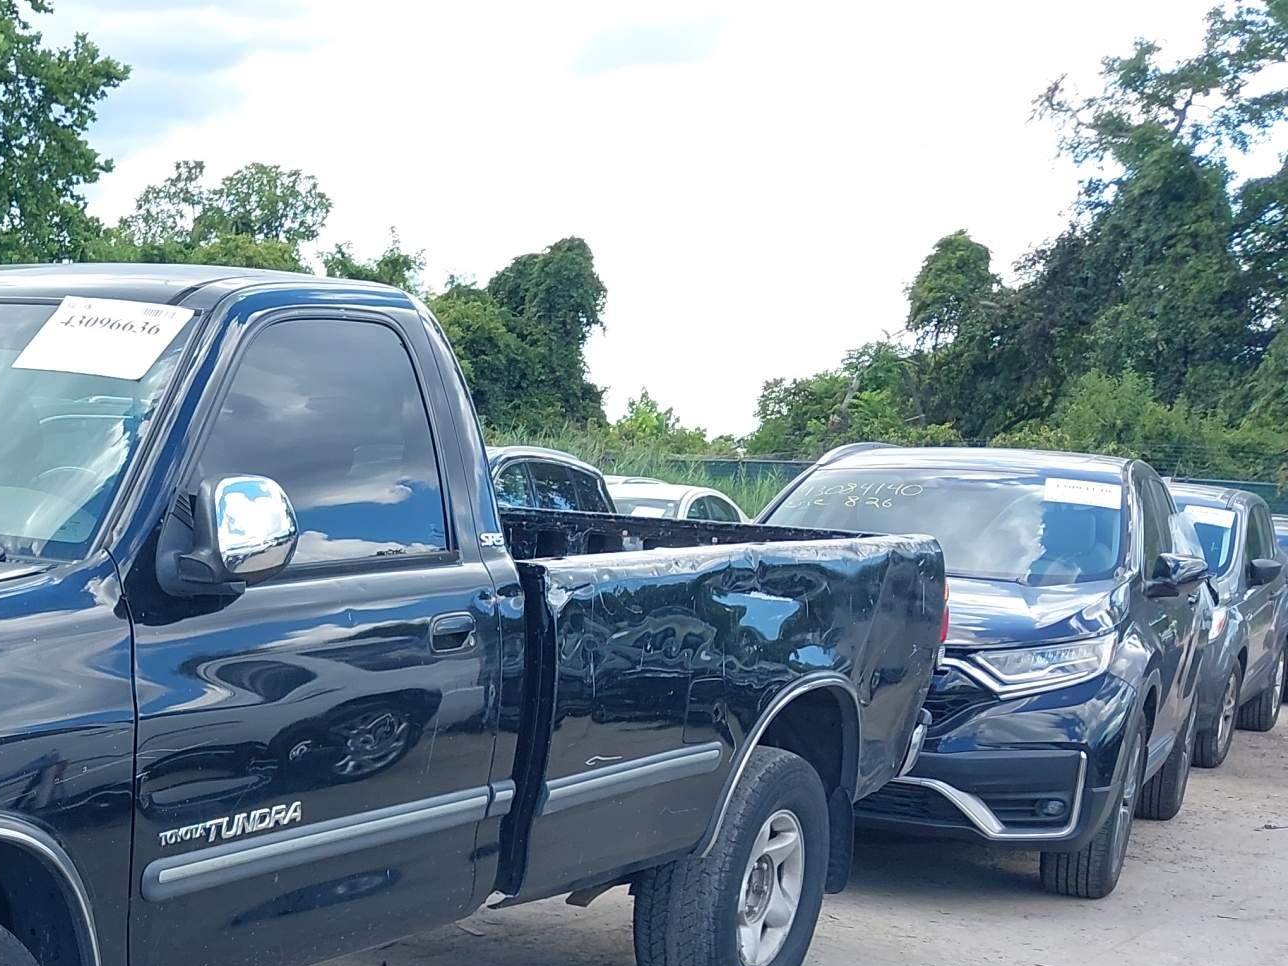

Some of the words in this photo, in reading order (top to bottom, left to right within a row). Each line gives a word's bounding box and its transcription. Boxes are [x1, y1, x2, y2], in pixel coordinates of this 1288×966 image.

[60, 315, 161, 336] 43096636
[159, 823, 206, 846] TOYOTA
[205, 801, 302, 842] TUNDRA
